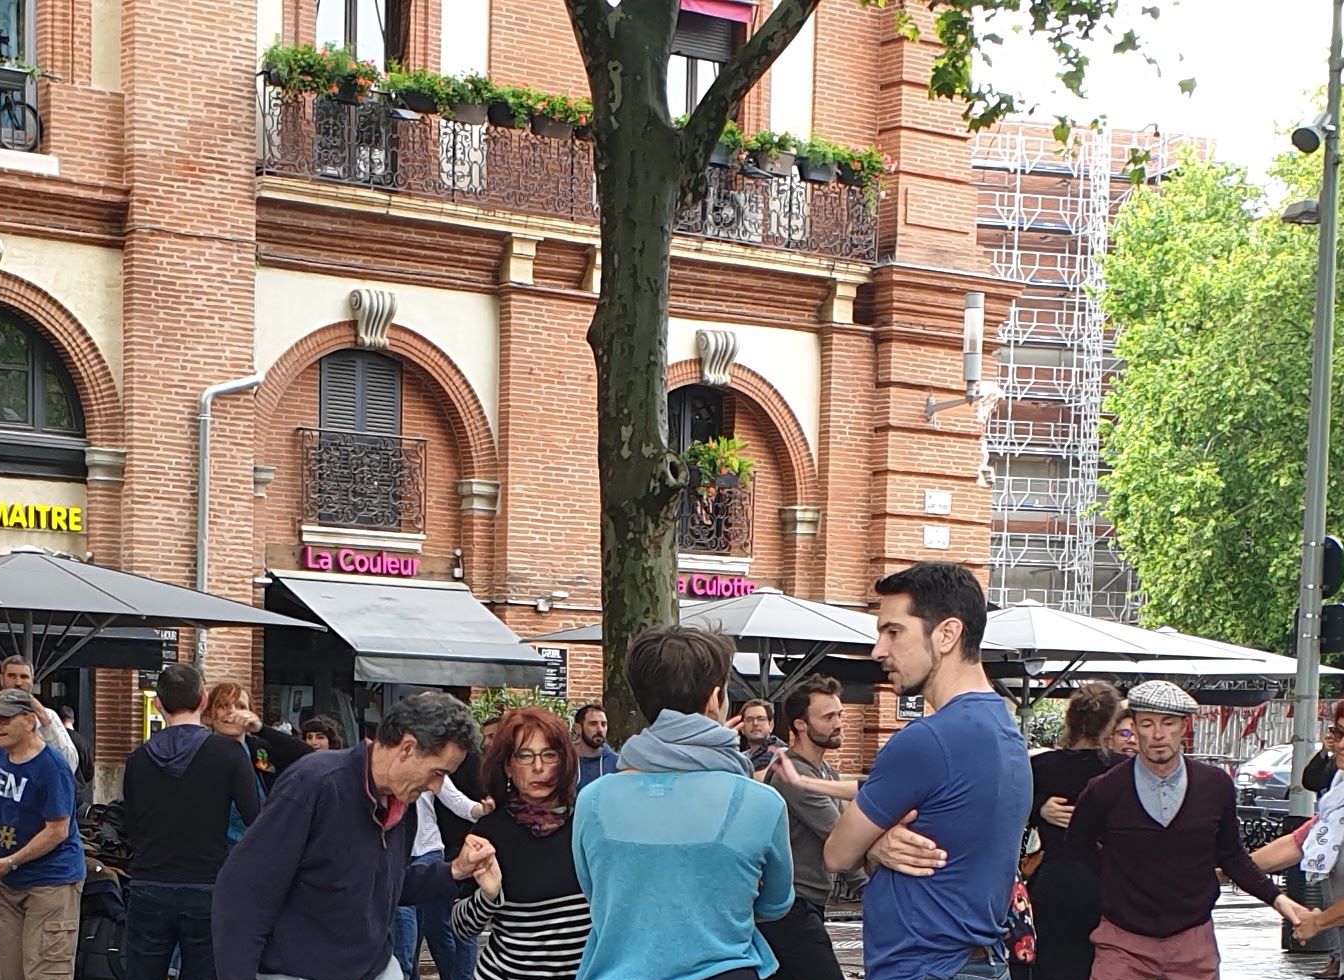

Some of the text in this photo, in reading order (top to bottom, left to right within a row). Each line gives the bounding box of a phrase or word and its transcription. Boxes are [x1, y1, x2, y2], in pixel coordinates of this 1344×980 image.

[305, 546, 421, 576] La Couleur
[691, 573, 757, 597] Culotte
